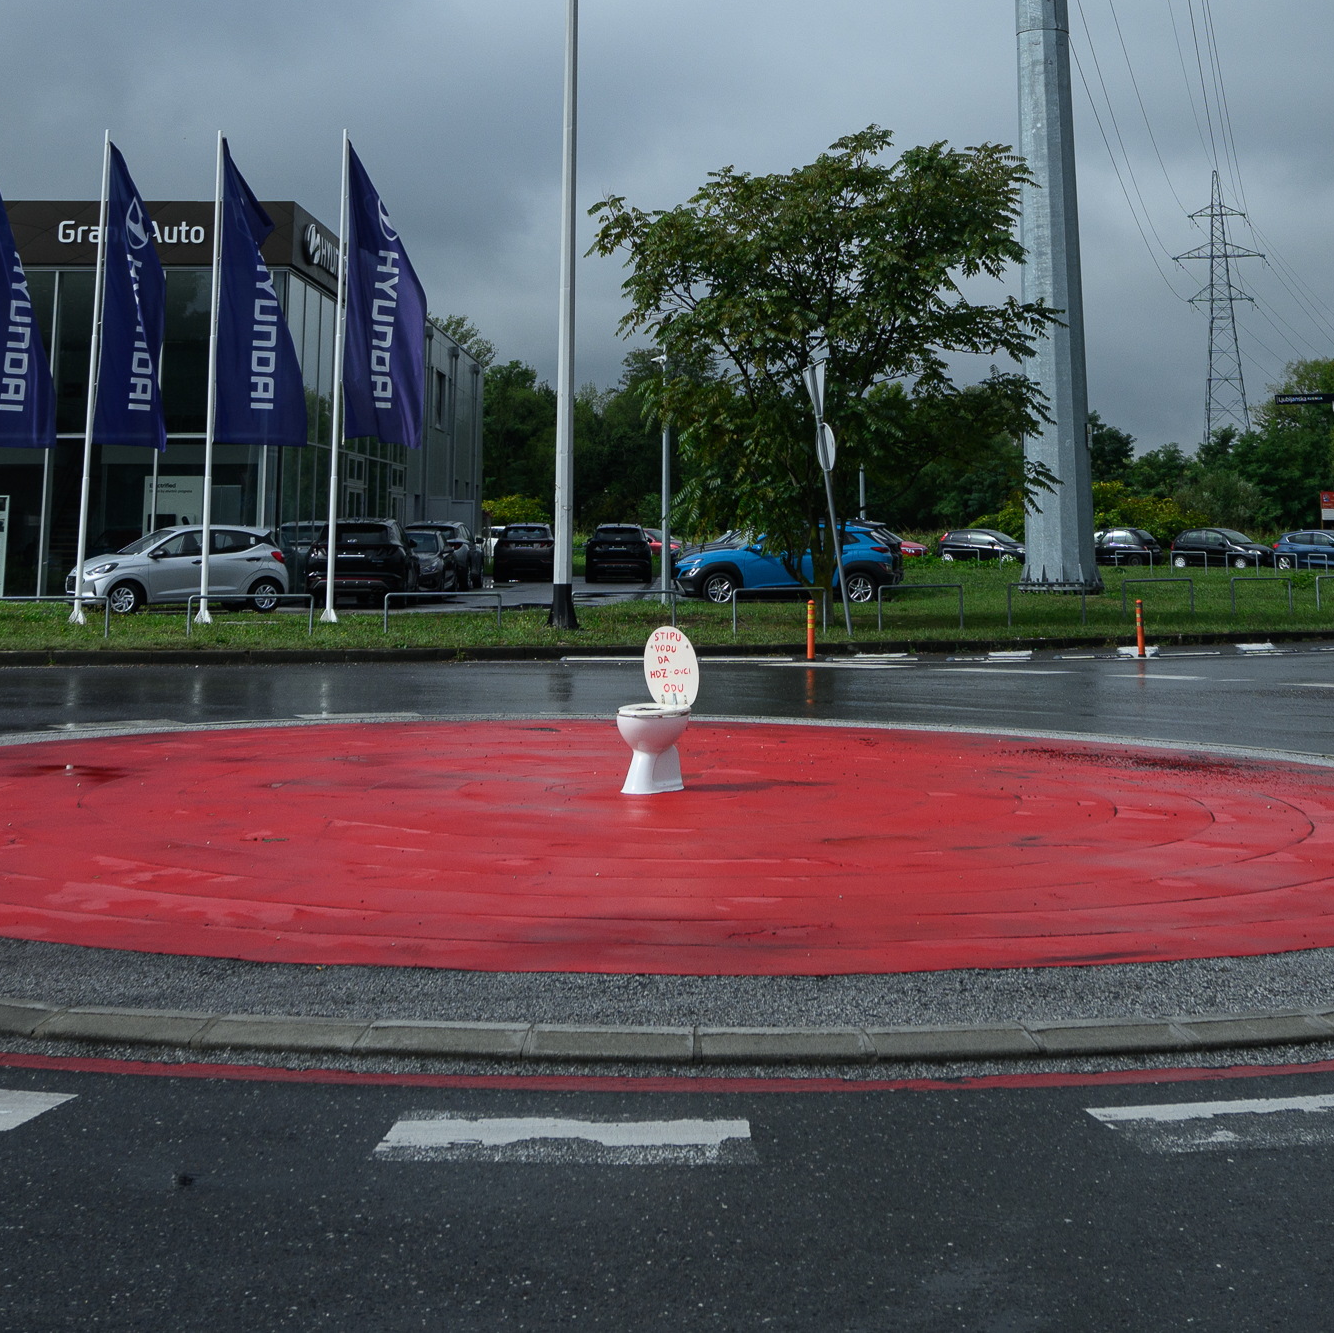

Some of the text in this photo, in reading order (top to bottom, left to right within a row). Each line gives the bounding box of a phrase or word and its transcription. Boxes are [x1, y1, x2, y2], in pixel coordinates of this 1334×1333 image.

[58, 221, 107, 243] Gra
[371, 250, 399, 408] HYUNDAI
[654, 632, 682, 642] STIPU
[654, 644, 677, 653] VODU
[657, 655, 670, 664] DA
[663, 683, 684, 693] ODU
